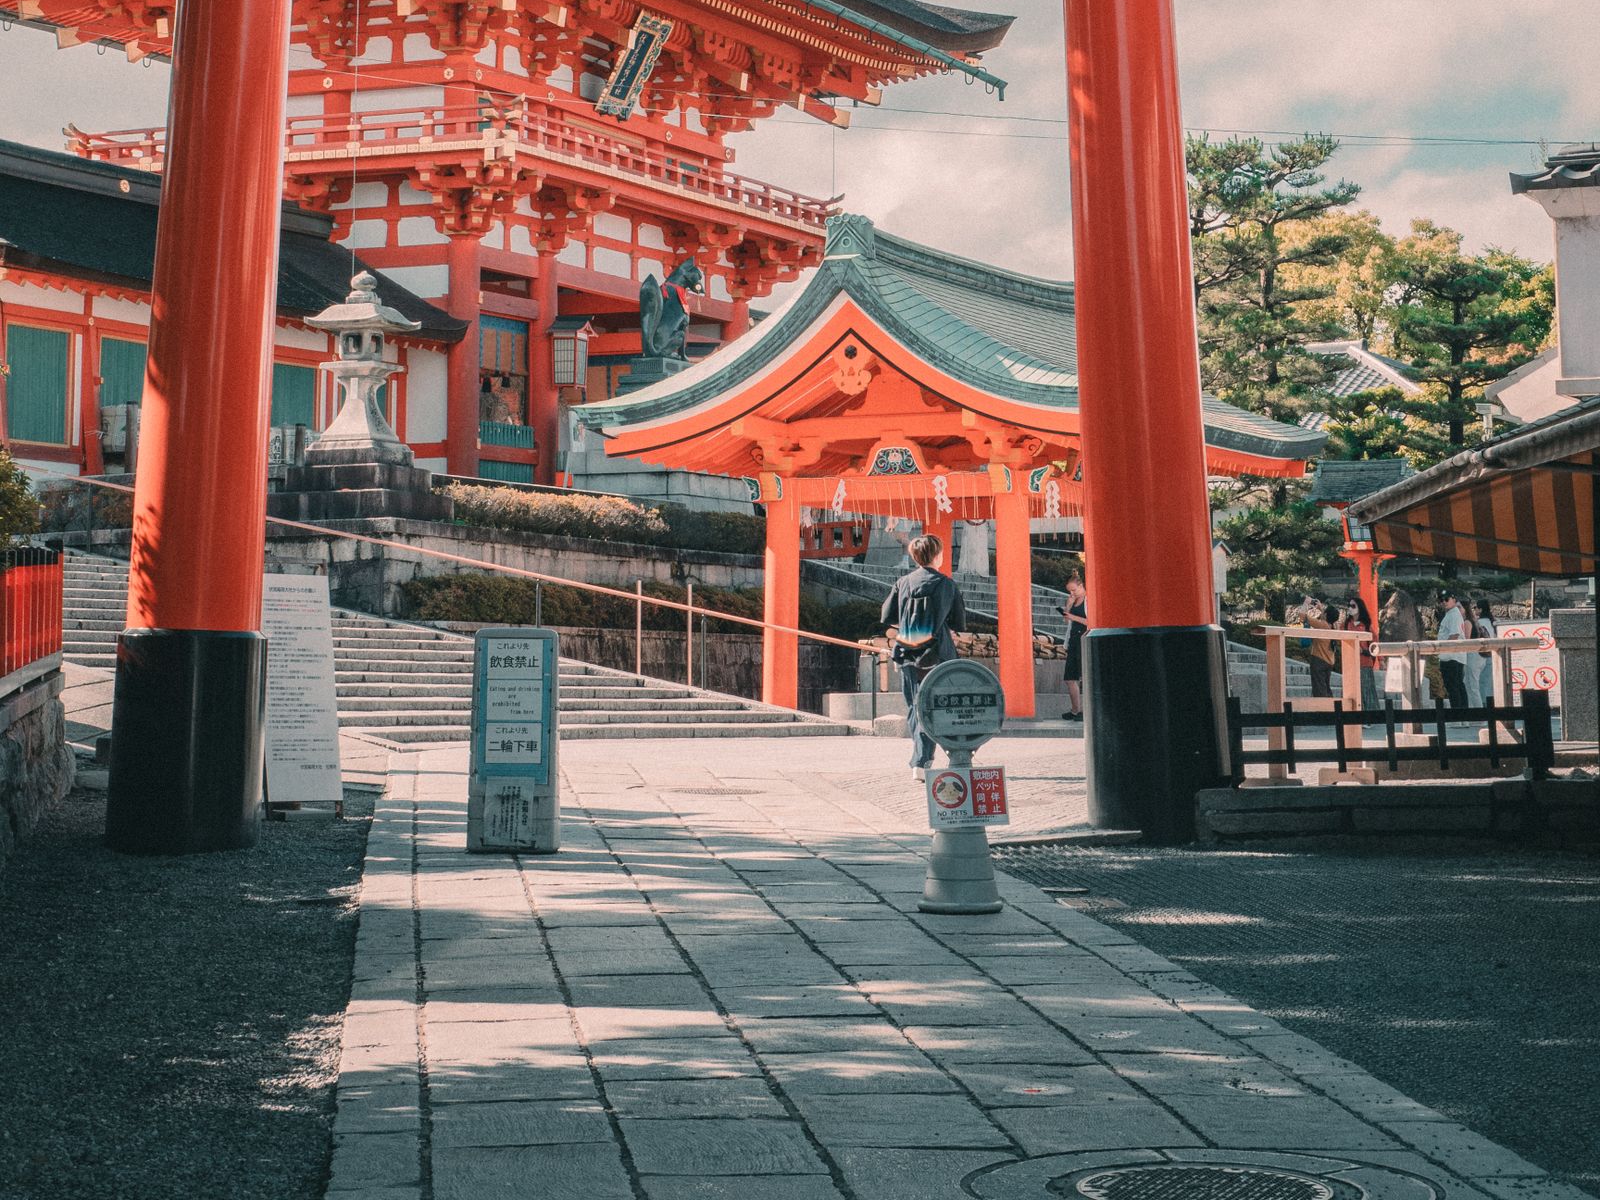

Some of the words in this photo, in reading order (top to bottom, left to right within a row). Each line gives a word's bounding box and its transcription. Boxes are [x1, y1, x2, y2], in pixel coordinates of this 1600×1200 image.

[490, 655, 540, 669] 飲食禁止
[950, 695, 992, 706] 飲食禁止
[495, 727, 529, 735] これより先
[488, 740, 539, 753] 二輪下車
[973, 770, 1000, 780] 敷地内
[976, 781, 999, 790] ペット
[977, 803, 1002, 814] 禁止
